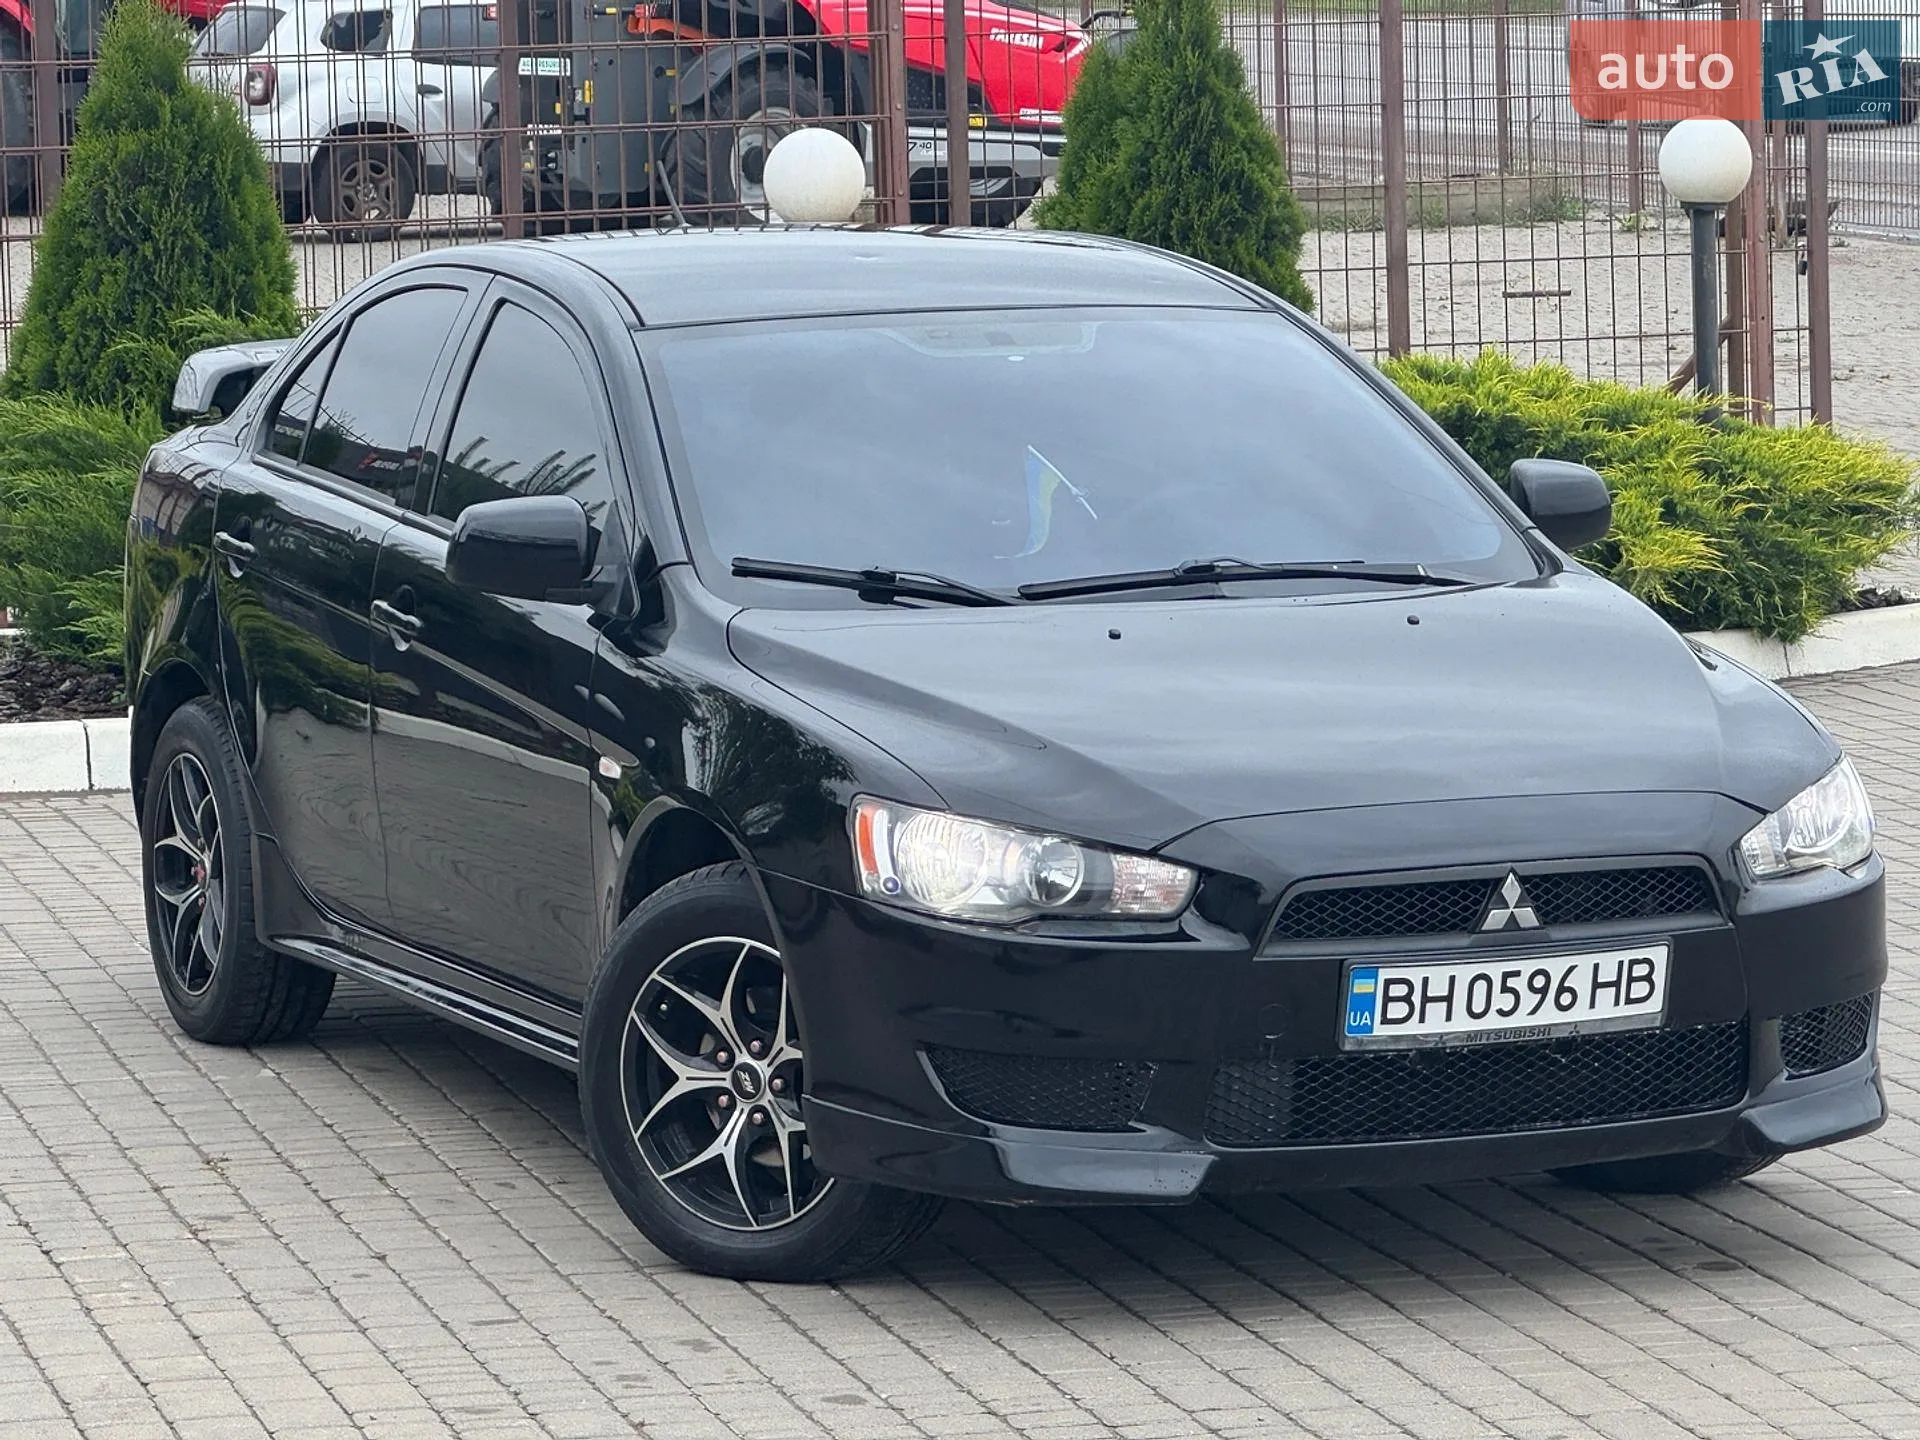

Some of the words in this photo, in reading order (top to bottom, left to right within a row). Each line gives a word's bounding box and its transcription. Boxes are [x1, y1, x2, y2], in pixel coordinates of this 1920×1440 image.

[1380, 974, 1457, 1026] BH
[1465, 964, 1579, 1020] 0596
[1588, 956, 1656, 1010] HB
[1350, 1011, 1372, 1027] UA
[1465, 1026, 1552, 1043] MITSUBISHI
